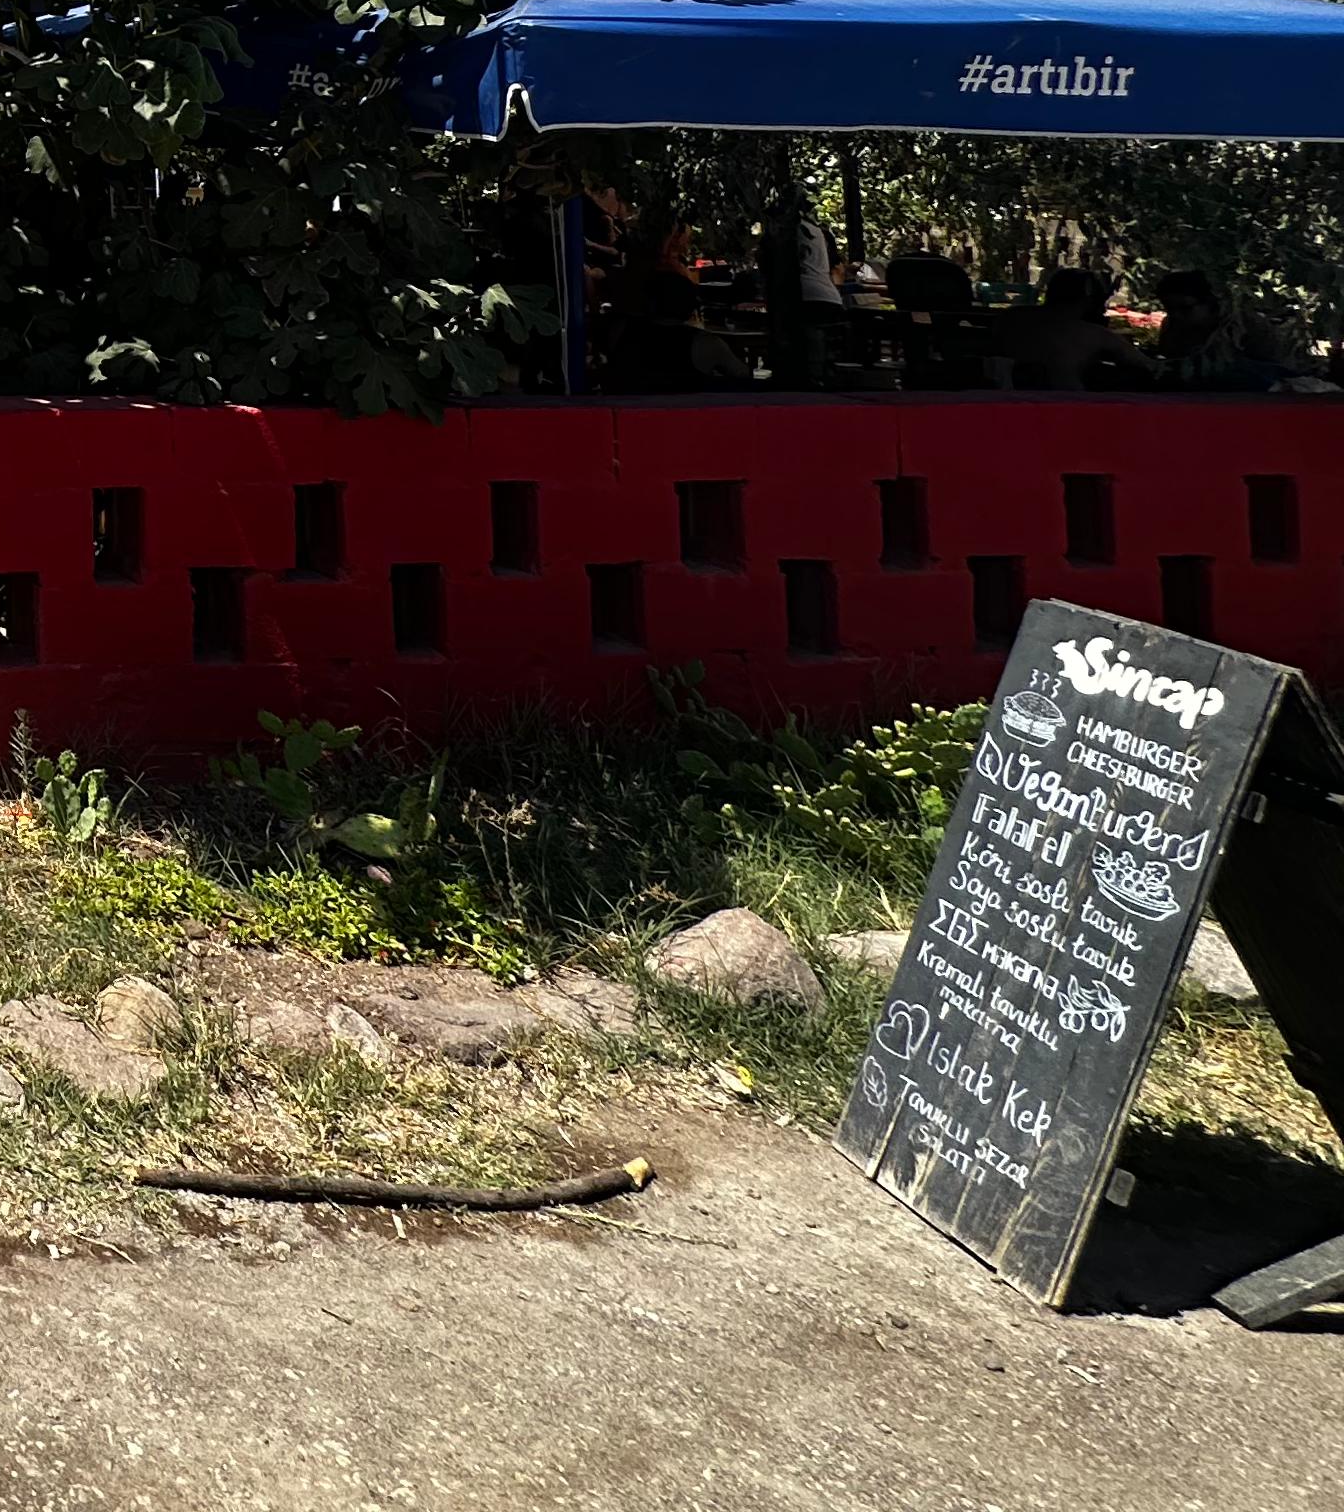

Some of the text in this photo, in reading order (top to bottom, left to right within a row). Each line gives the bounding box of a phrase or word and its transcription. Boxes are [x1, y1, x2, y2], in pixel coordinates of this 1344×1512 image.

[1068, 637, 1224, 729] Sincap
[1077, 715, 1202, 782] HAMBURGER
[949, 861, 1002, 915] Soya
[1002, 1080, 1052, 1148] Kek
